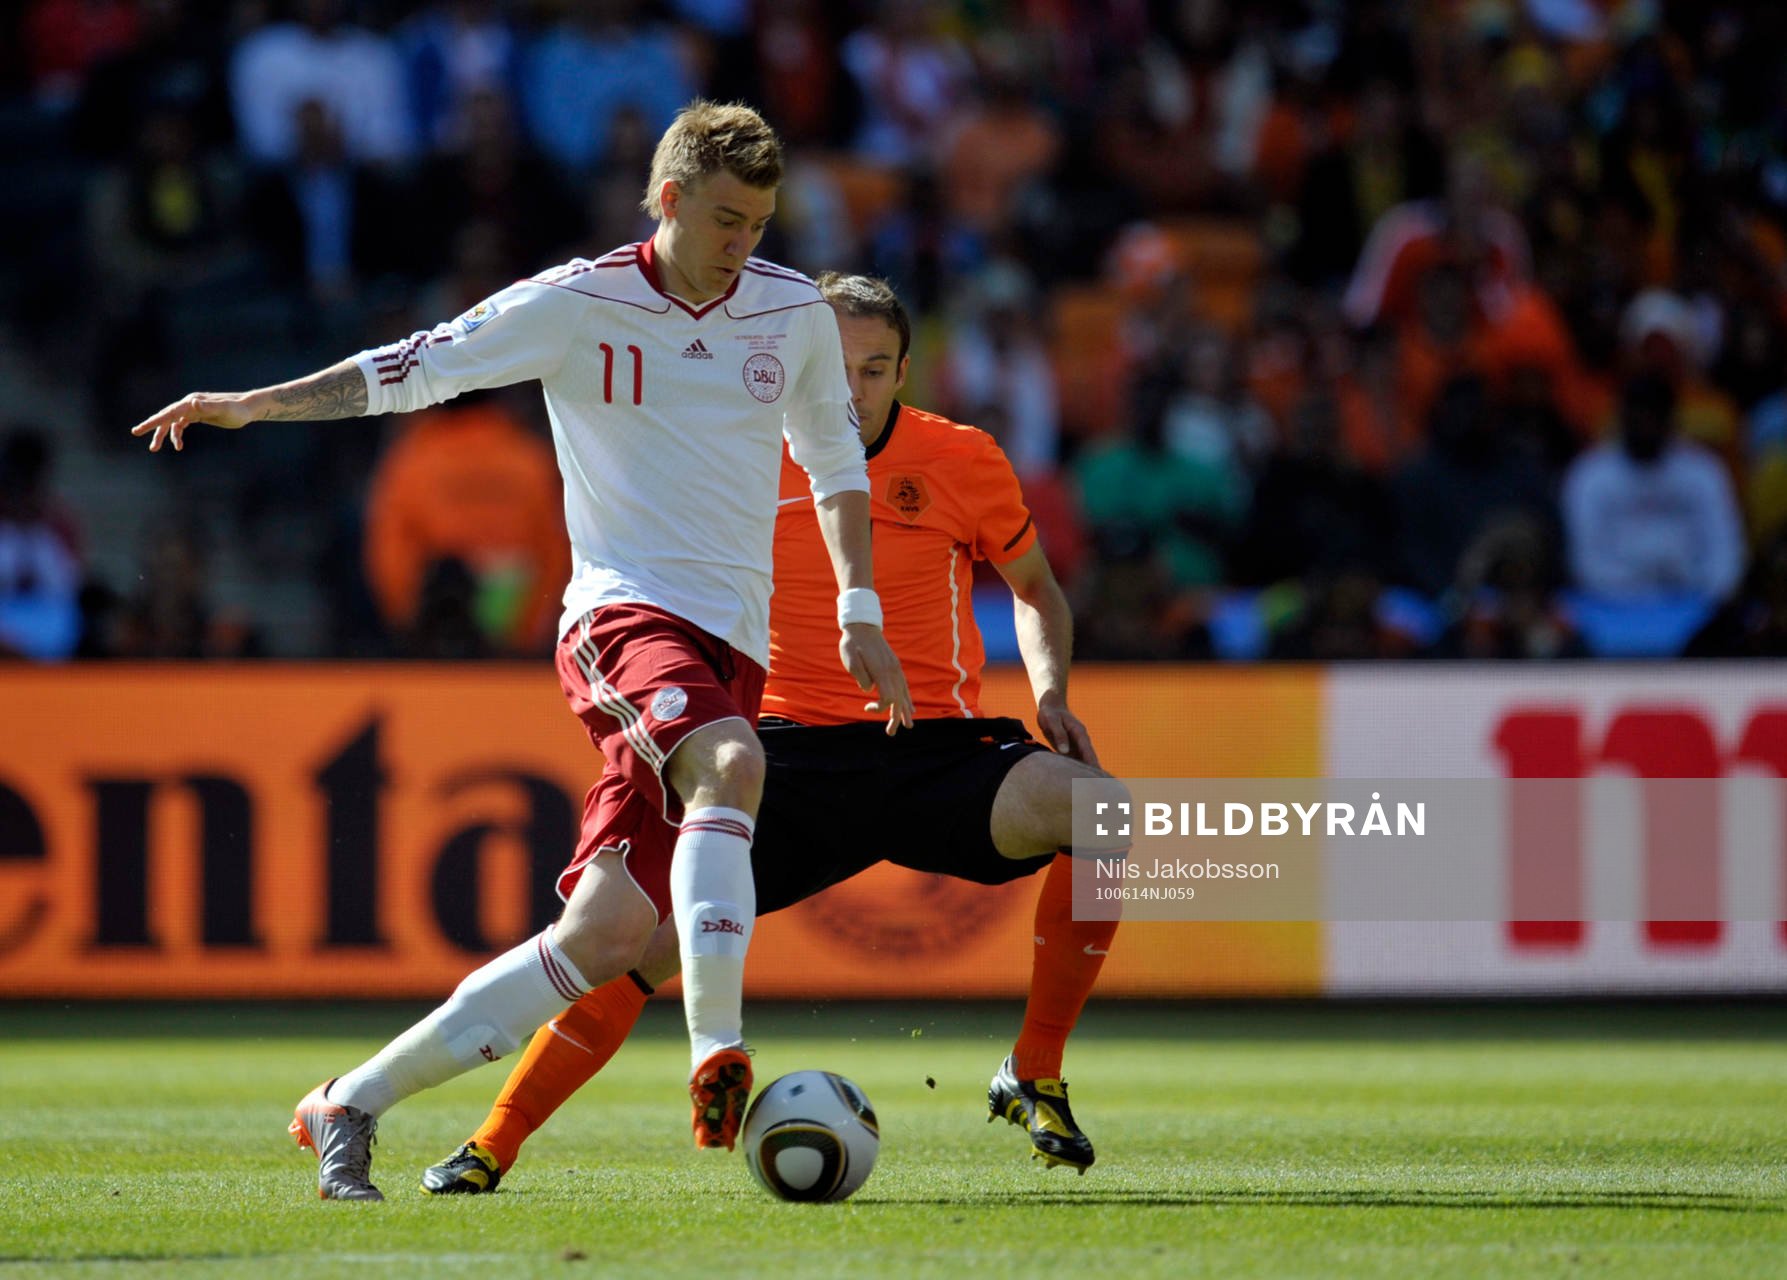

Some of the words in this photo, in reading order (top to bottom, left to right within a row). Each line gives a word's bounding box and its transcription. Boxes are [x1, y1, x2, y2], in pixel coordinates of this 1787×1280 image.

[681, 351, 714, 360] adidas
[599, 342, 643, 406] 11
[753, 369, 776, 385] DBU
[701, 919, 744, 936] DBU
